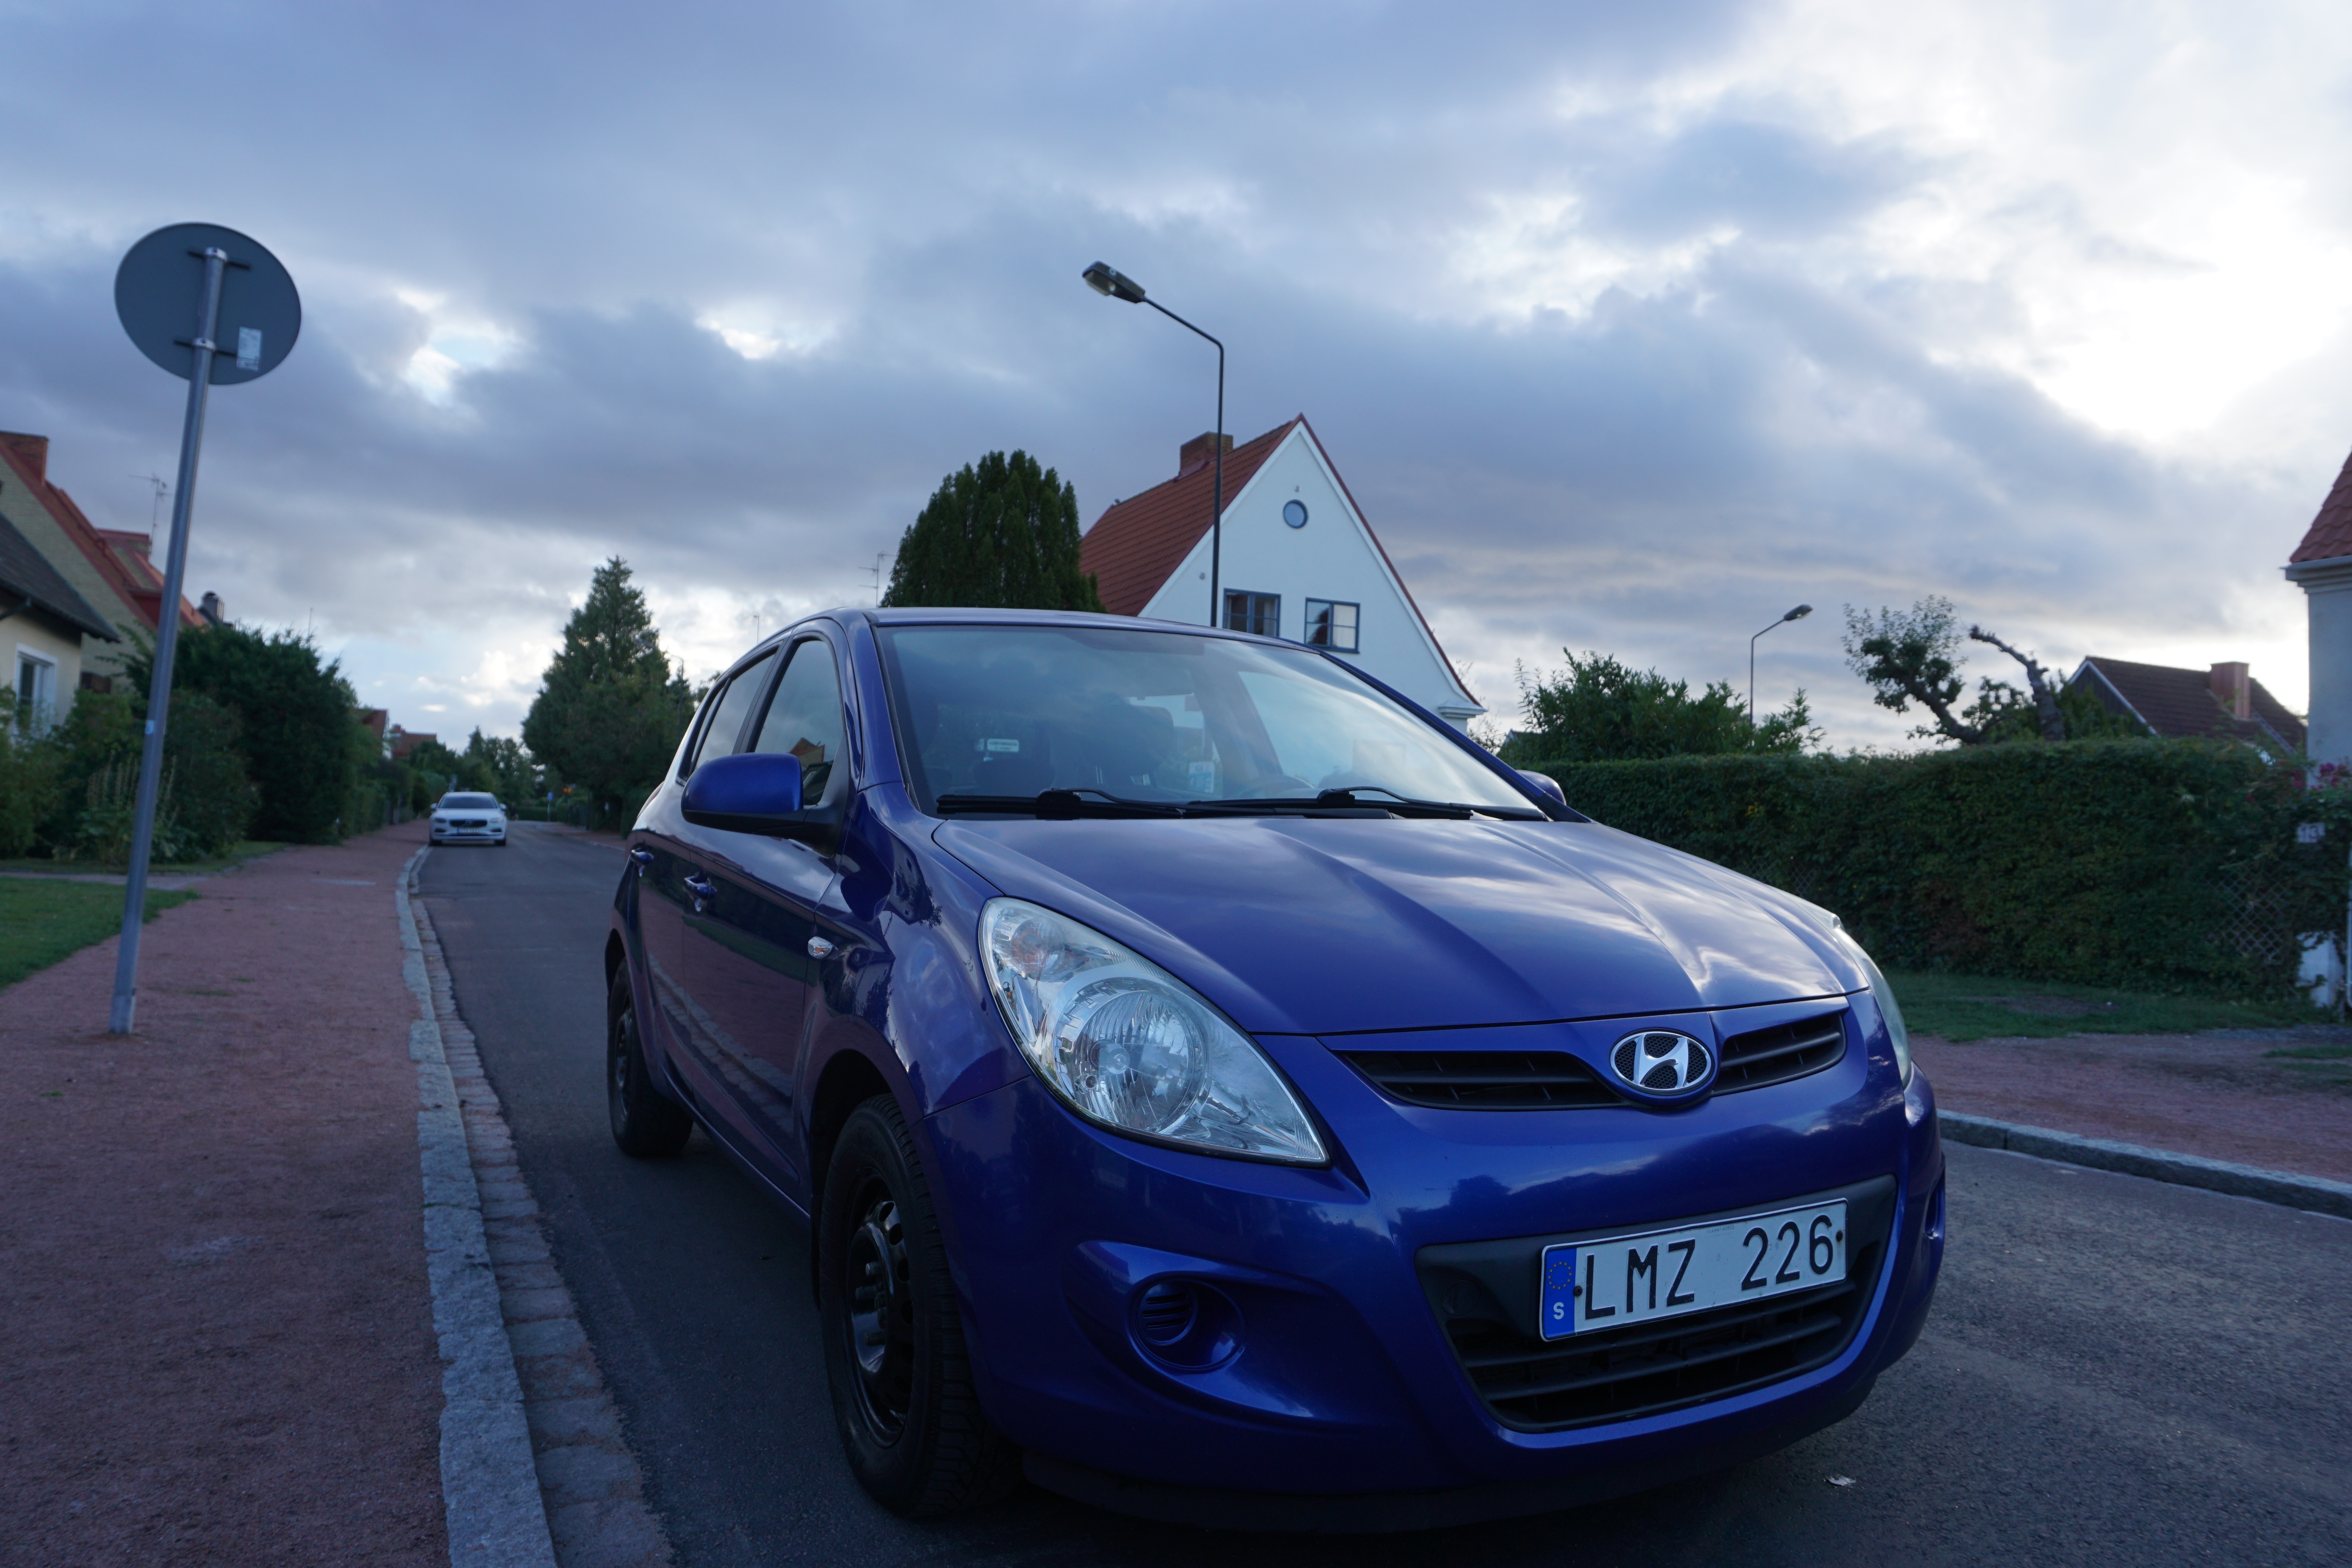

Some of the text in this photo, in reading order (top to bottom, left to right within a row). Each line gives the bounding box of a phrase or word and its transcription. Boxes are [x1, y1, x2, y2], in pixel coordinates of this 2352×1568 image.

[1585, 1214, 1833, 1320] LMZ 226
[1553, 1302, 1564, 1320] S
